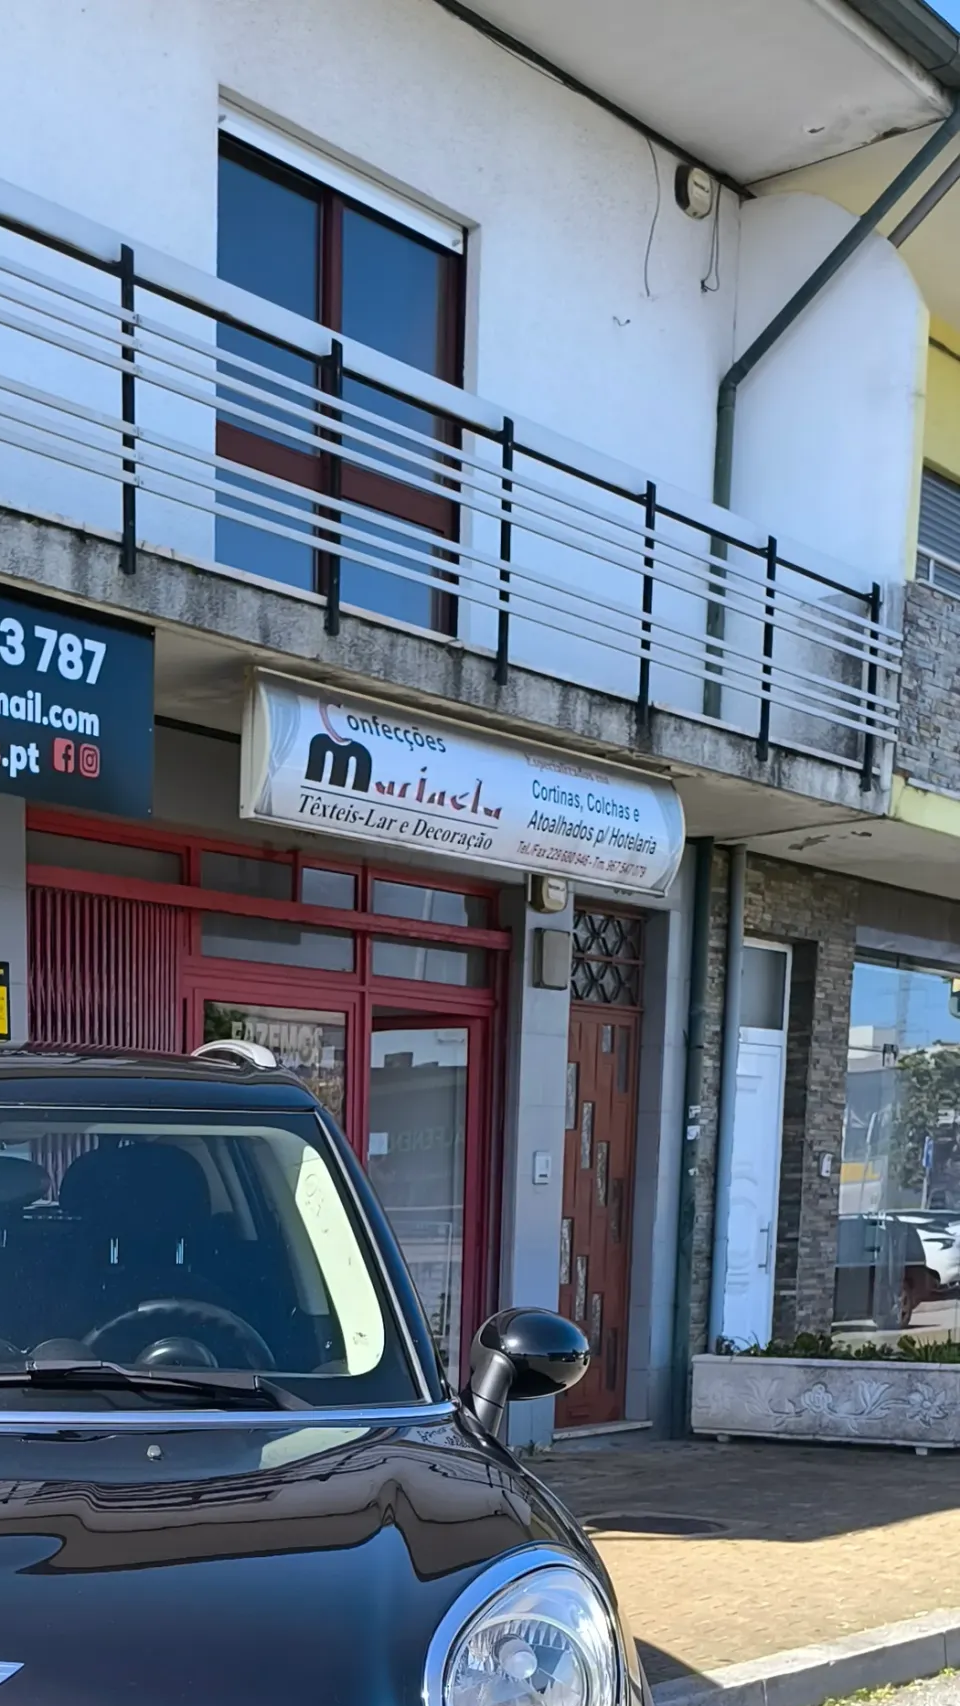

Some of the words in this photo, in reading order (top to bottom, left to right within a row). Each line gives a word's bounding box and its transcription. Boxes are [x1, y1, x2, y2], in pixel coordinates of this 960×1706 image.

[34, 625, 106, 685] 787
[299, 793, 398, 831] Têxteis-Lar
[399, 820, 410, 834] e
[412, 818, 493, 850] Decoração
[532, 779, 583, 812] Cortinas,
[587, 792, 630, 820] Colchas
[633, 808, 640, 822] e
[527, 810, 594, 841] Atoalhados
[593, 826, 610, 848] p/
[608, 827, 657, 855] Hotelaria
